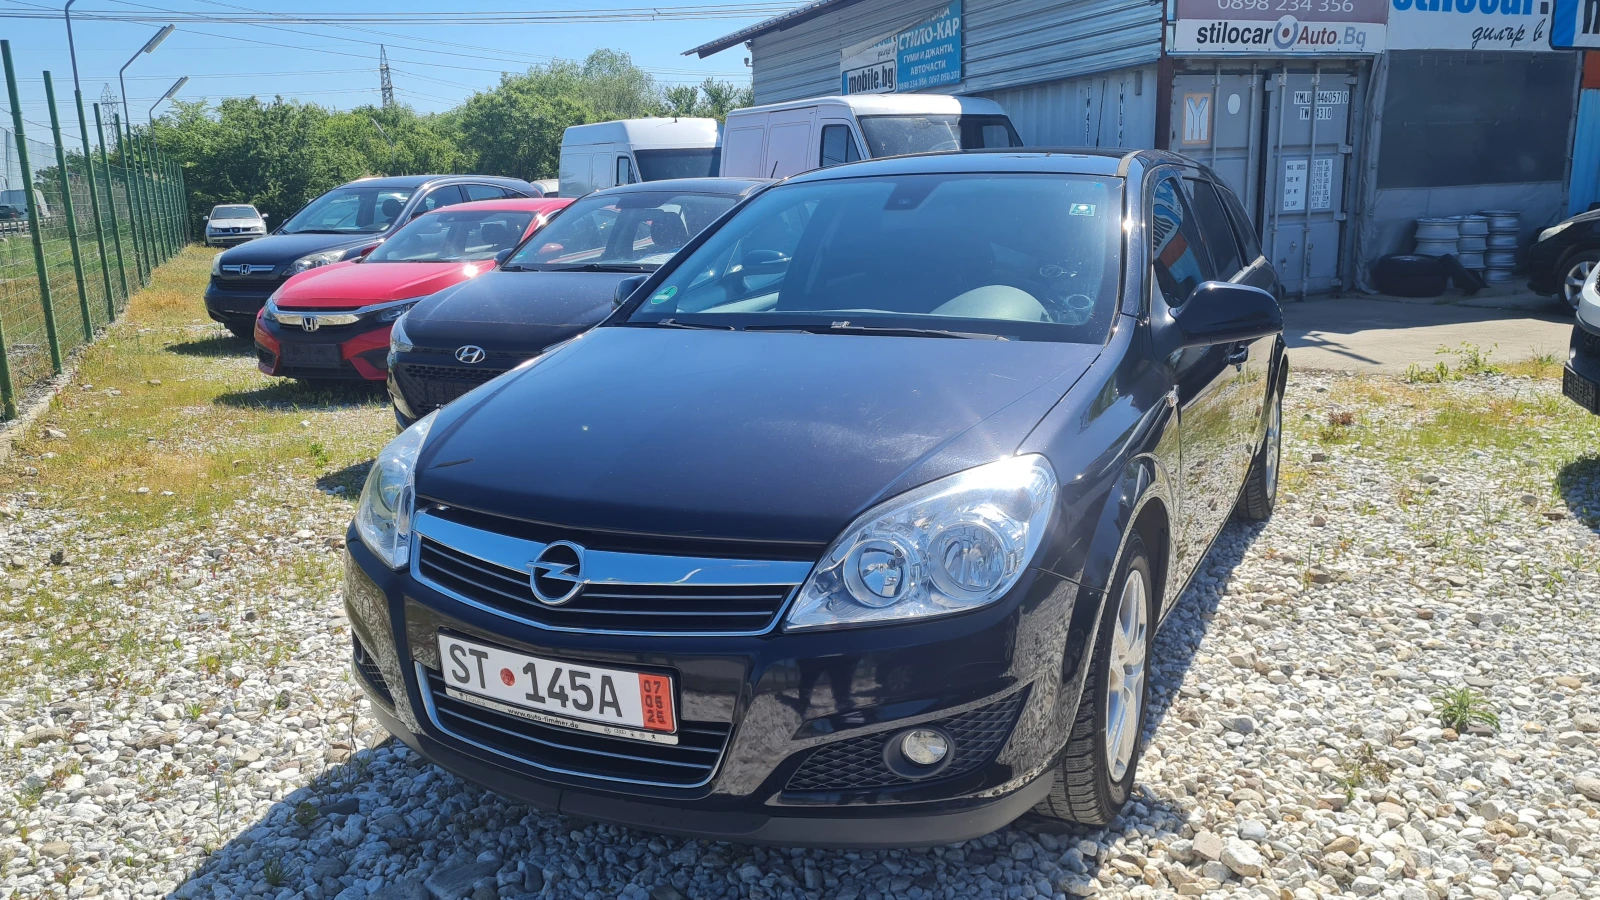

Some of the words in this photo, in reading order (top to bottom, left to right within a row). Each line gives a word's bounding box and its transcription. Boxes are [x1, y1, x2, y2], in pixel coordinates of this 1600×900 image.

[899, 17, 960, 50] СТИЛО-КАР
[1196, 22, 1272, 44] stilocar
[903, 52, 919, 64] ГУМИ
[910, 59, 946, 76] АВТОЧАСТИ
[849, 65, 894, 94] mobile.bg
[1295, 92, 1312, 104] YMLU
[1300, 107, 1310, 119] TW
[449, 643, 489, 690] ST
[522, 661, 623, 718] 145A
[643, 680, 661, 694] 07
[645, 694, 663, 709] 05
[647, 709, 667, 724] 25
